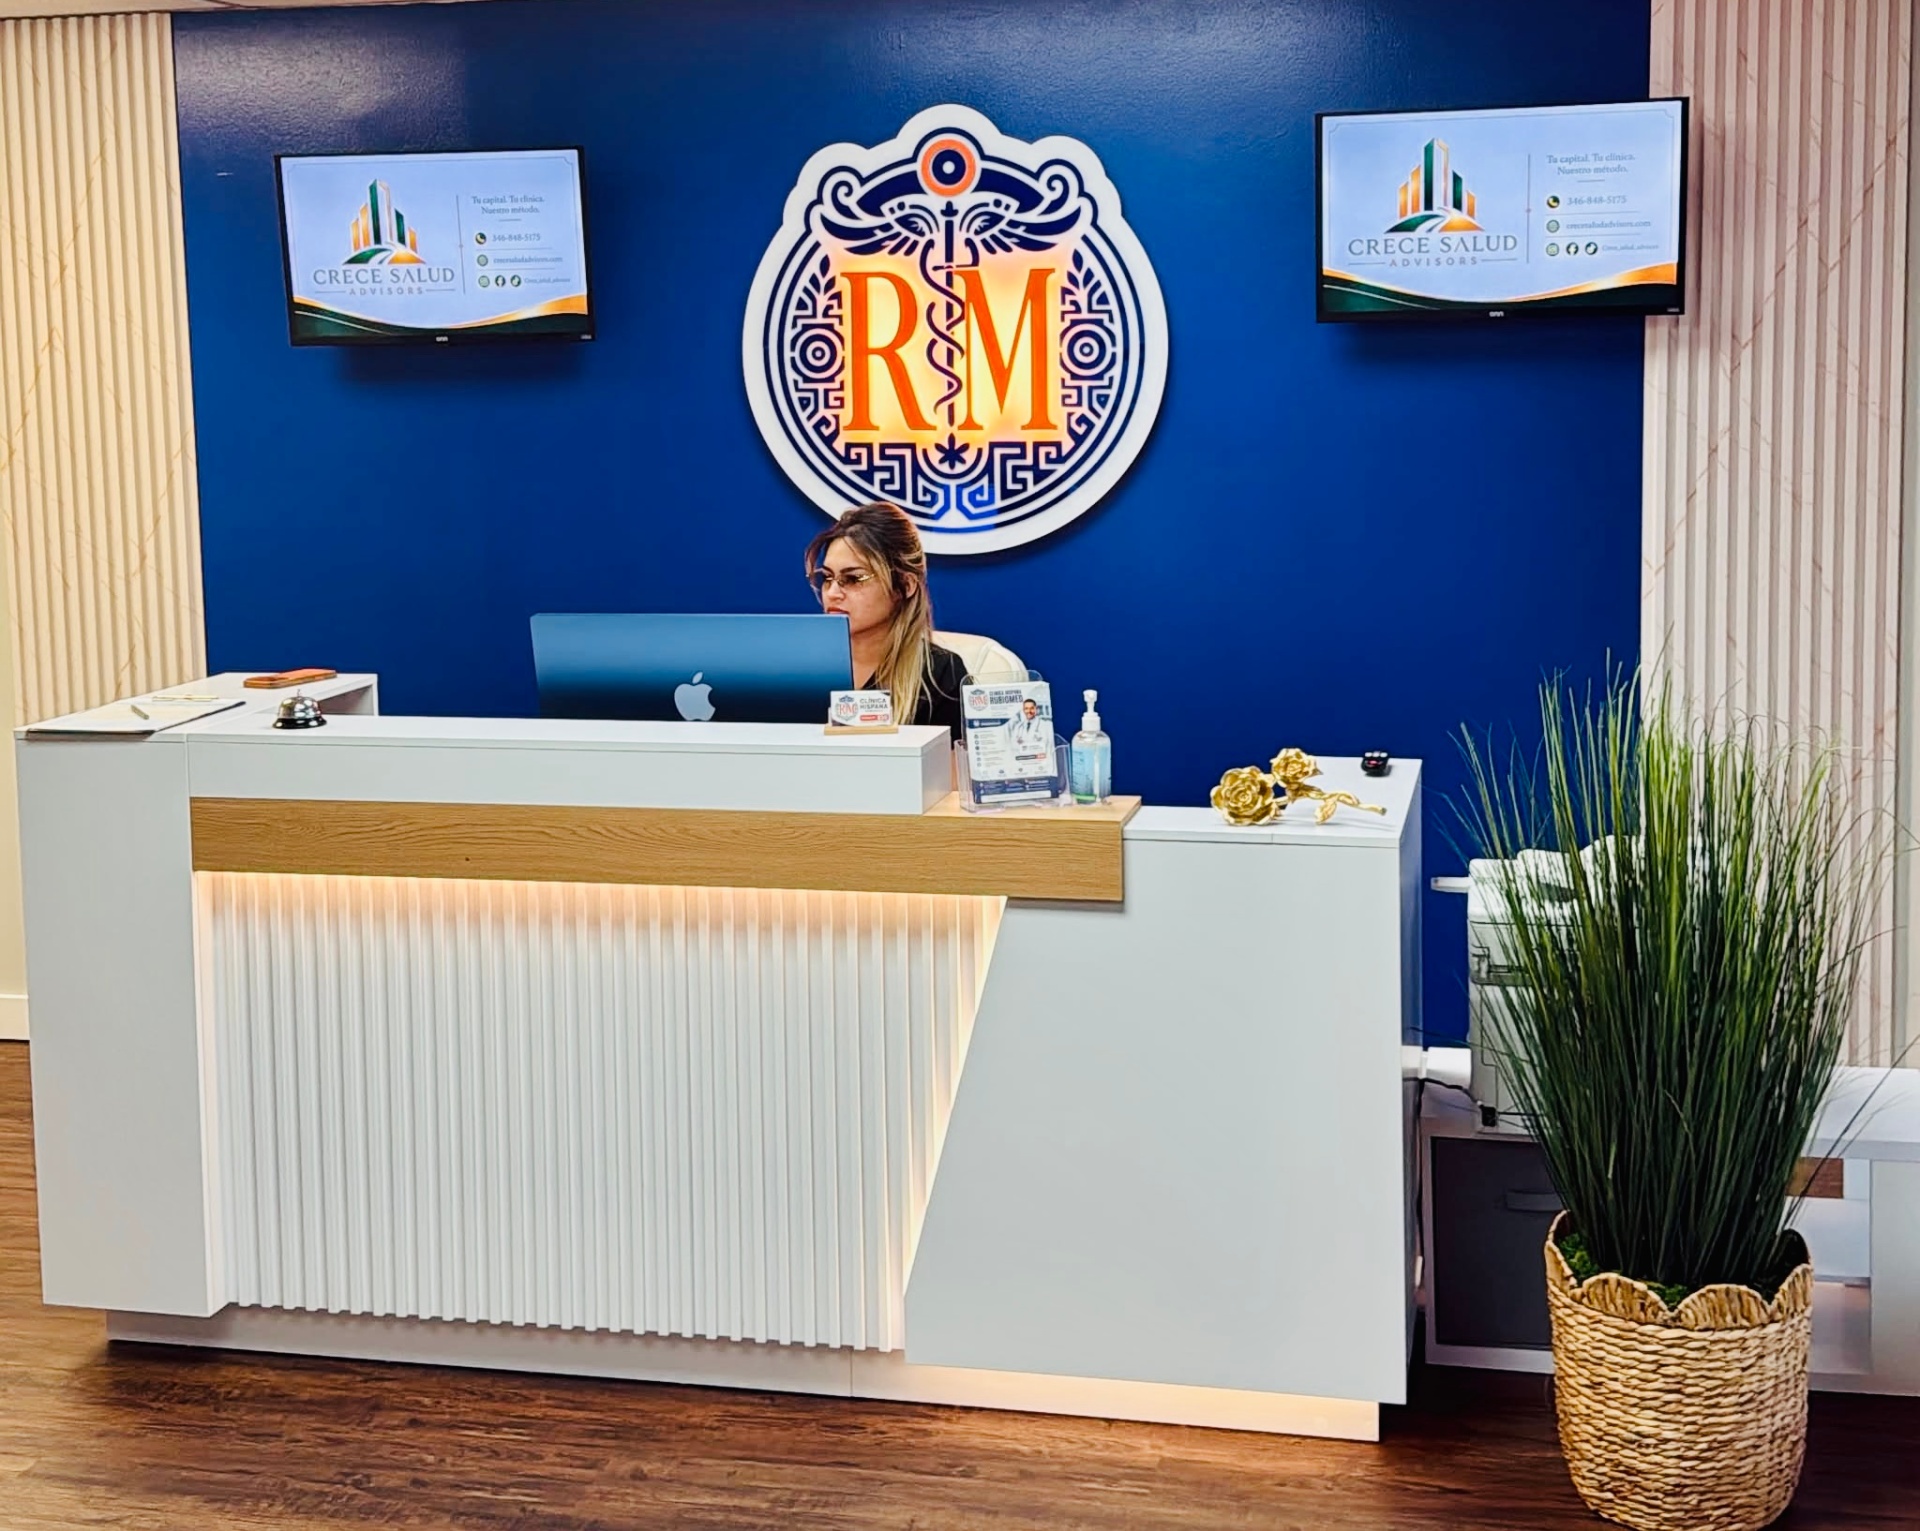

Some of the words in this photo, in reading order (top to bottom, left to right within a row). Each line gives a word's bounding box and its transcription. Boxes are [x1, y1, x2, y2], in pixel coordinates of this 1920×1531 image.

[1546, 154, 1558, 164] Tu
[1592, 153, 1603, 162] Tu
[1557, 166, 1591, 175] Nuestro
[1348, 237, 1430, 256] CRECE
[1439, 235, 1517, 254] SALUD
[1389, 256, 1477, 267] ADVISORS
[313, 268, 382, 285] CRECE
[390, 267, 455, 284] SALUD
[349, 286, 423, 296] ADVISORS
